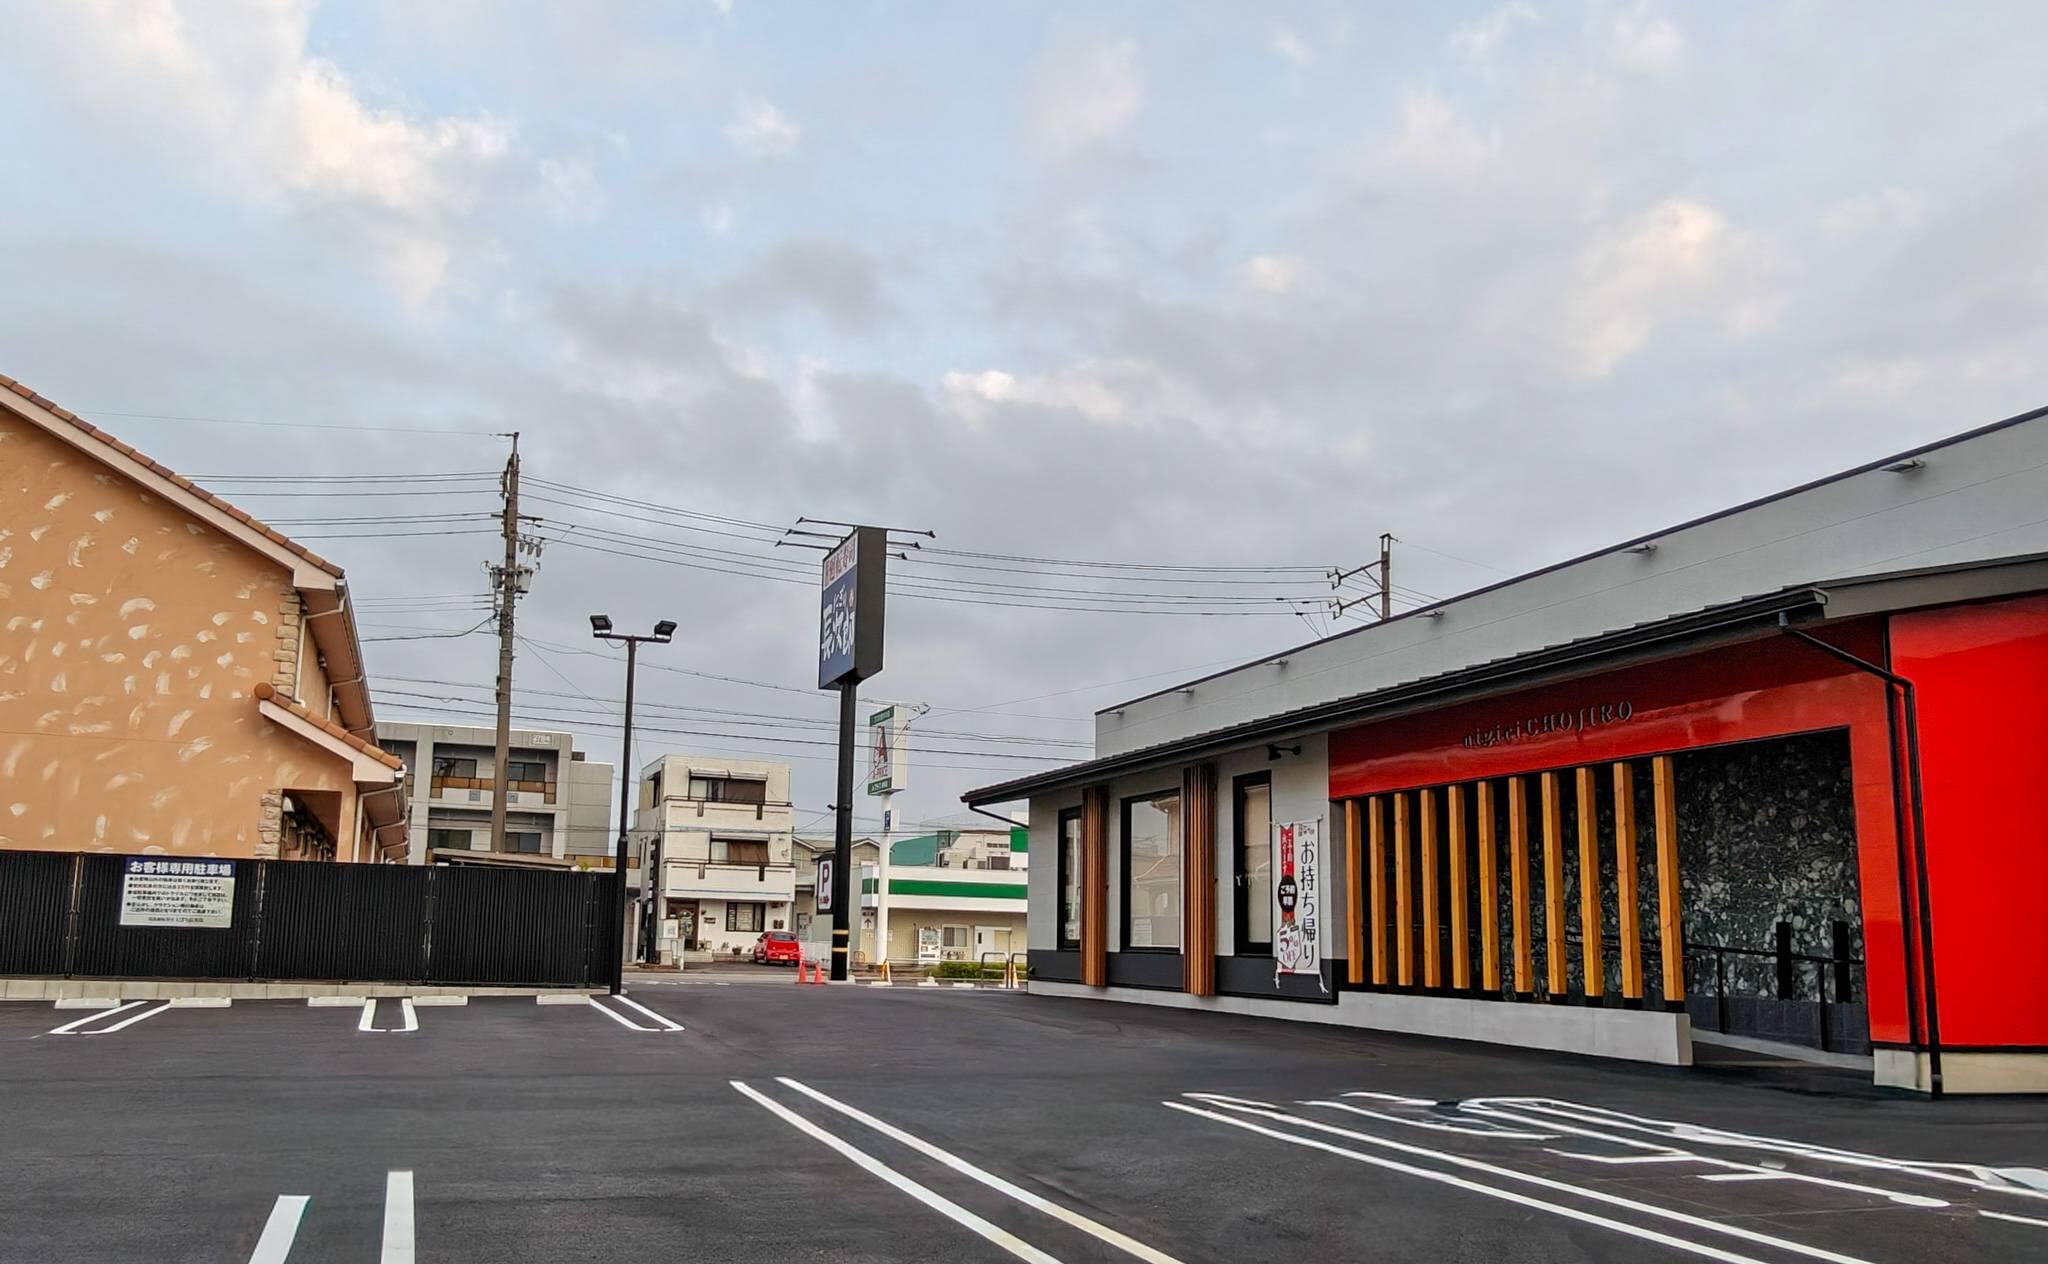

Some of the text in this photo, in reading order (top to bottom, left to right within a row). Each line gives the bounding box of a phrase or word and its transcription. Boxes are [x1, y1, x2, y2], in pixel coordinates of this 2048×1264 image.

[129, 860, 232, 877] お客様専用駐車場
[821, 863, 830, 892] P
[1300, 840, 1316, 969] お持ち帰り
